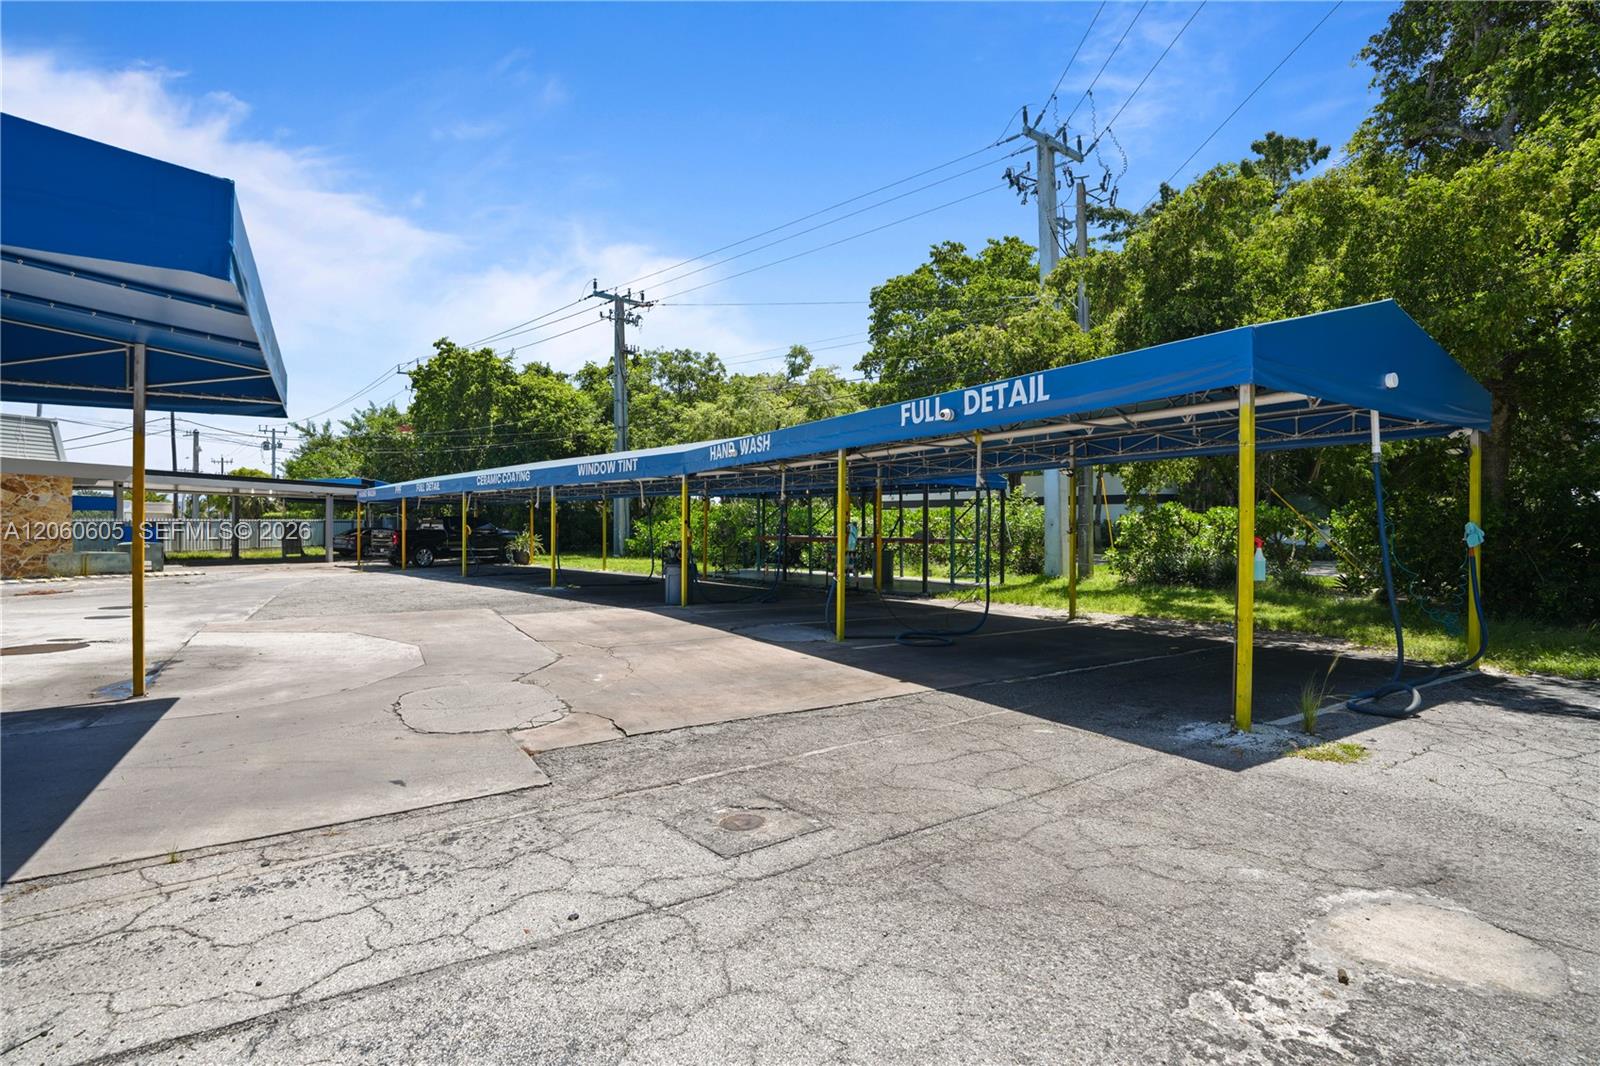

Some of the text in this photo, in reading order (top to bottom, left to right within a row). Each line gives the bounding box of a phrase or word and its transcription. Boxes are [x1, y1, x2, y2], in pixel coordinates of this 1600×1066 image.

[901, 375, 1050, 427] FULL DETAIL
[709, 434, 771, 461] HAND WASH
[577, 458, 638, 476] WINDOW TINT
[476, 471, 531, 486] CERAMIC COATING
